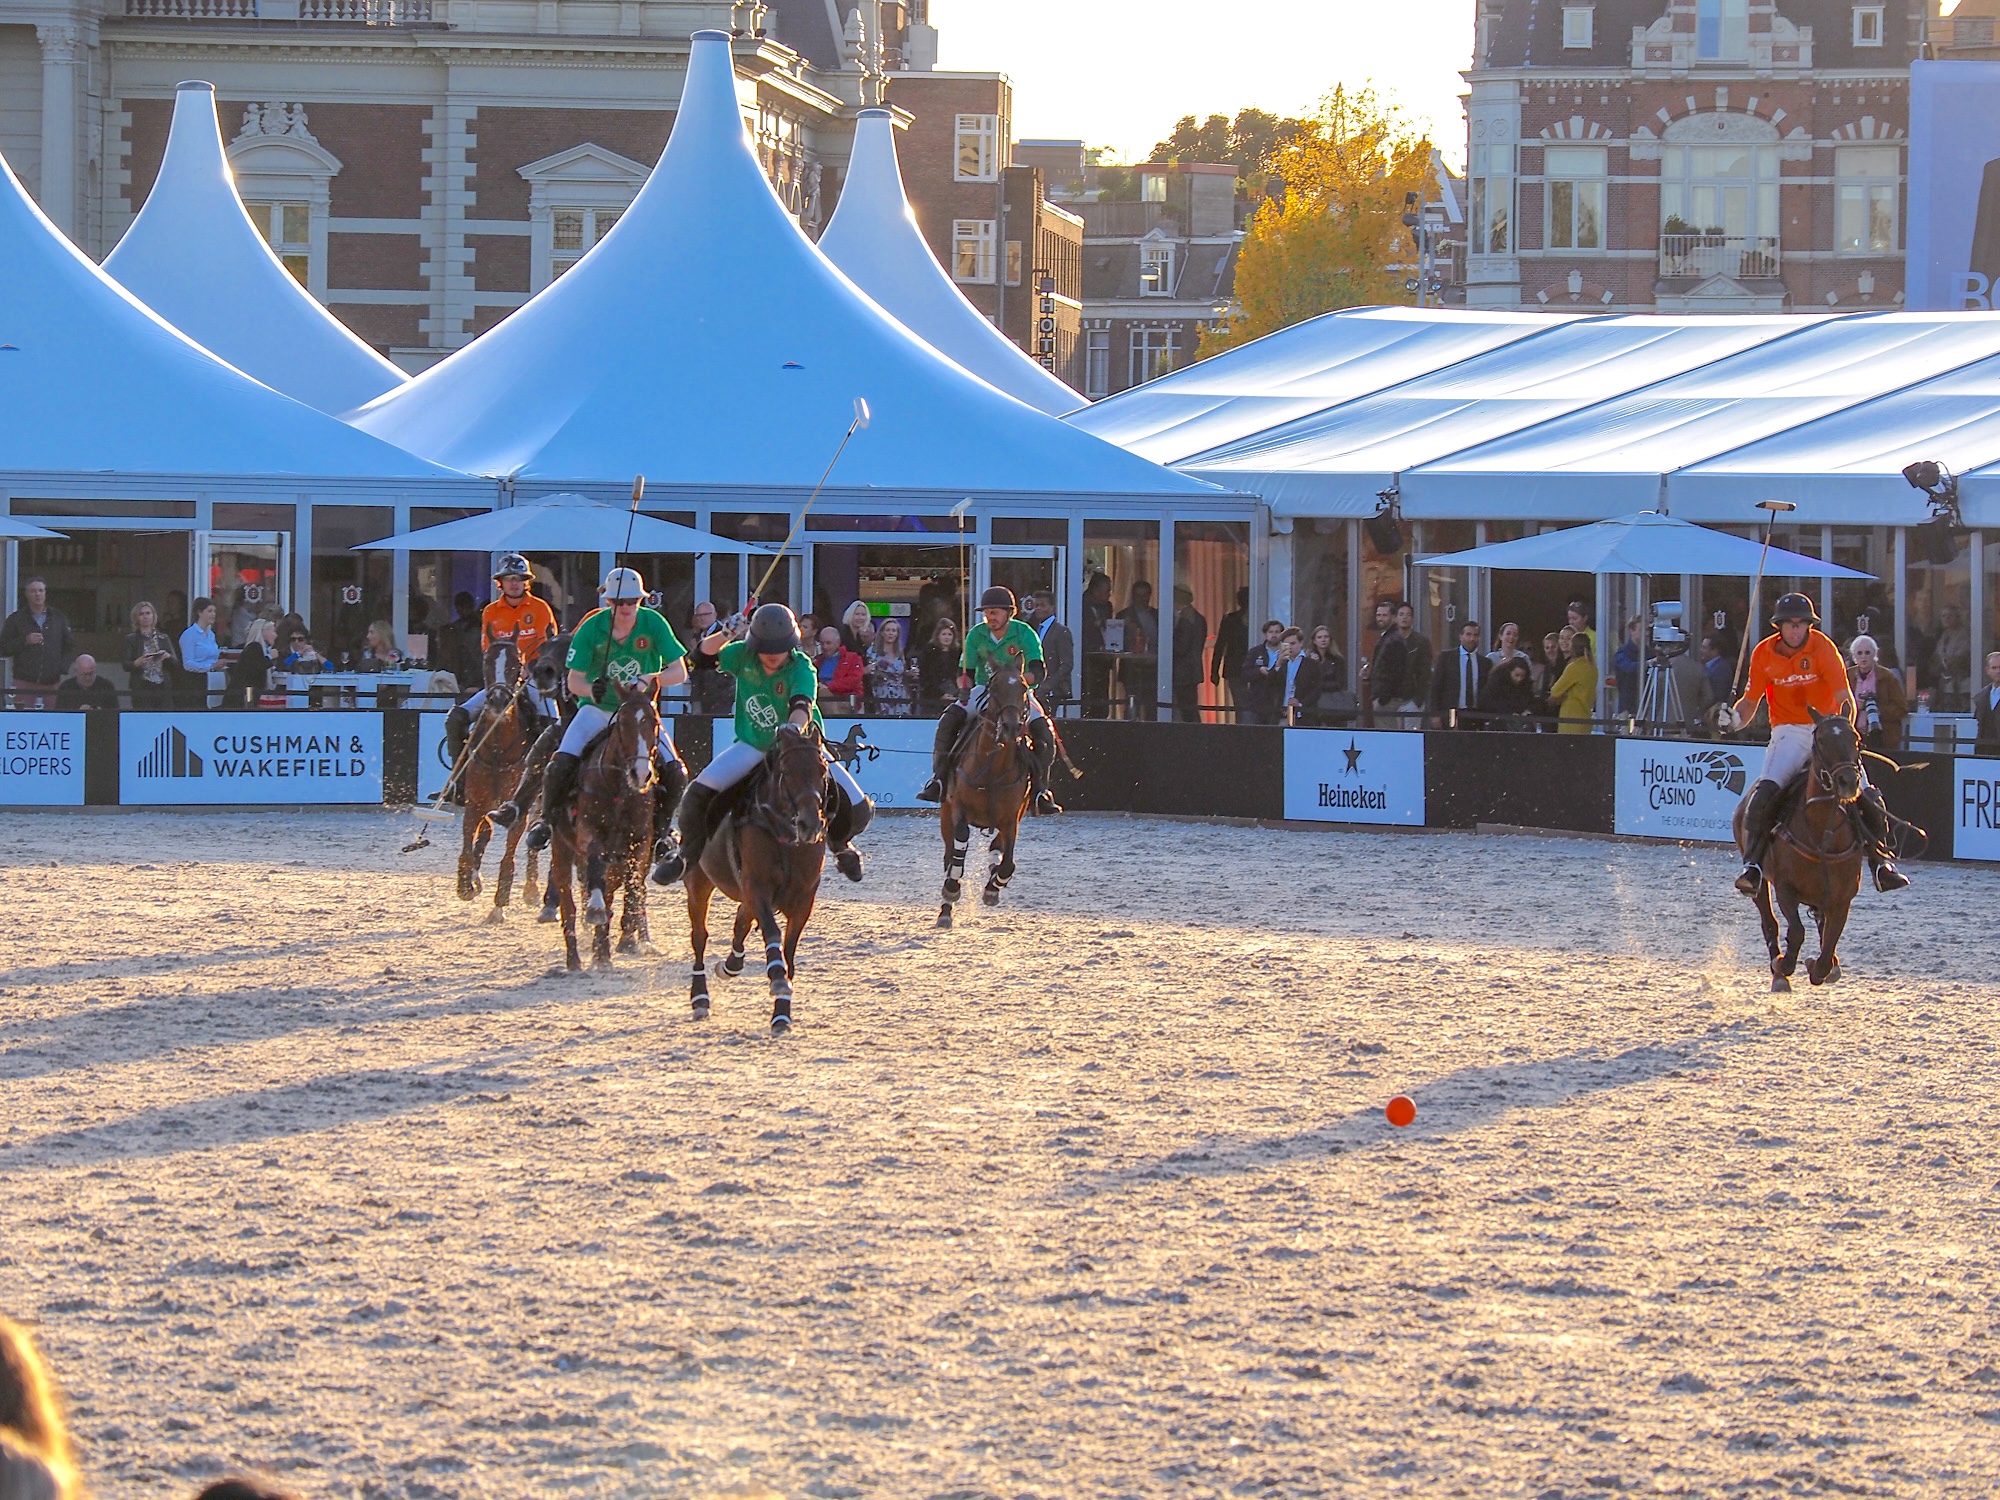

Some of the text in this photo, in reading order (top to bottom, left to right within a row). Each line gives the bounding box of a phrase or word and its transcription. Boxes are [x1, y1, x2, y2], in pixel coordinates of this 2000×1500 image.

[1951, 272, 2000, 311] B
[6, 731, 70, 750] ESTATE
[213, 735, 364, 754] CUSHMAN &
[0, 757, 72, 776] LOPERS
[213, 759, 365, 778] WAKEFIELD
[1640, 758, 1703, 786] HOLLAND
[864, 792, 894, 803] OLO
[1318, 783, 1387, 810] Heineken
[1650, 784, 1696, 810] CASINO
